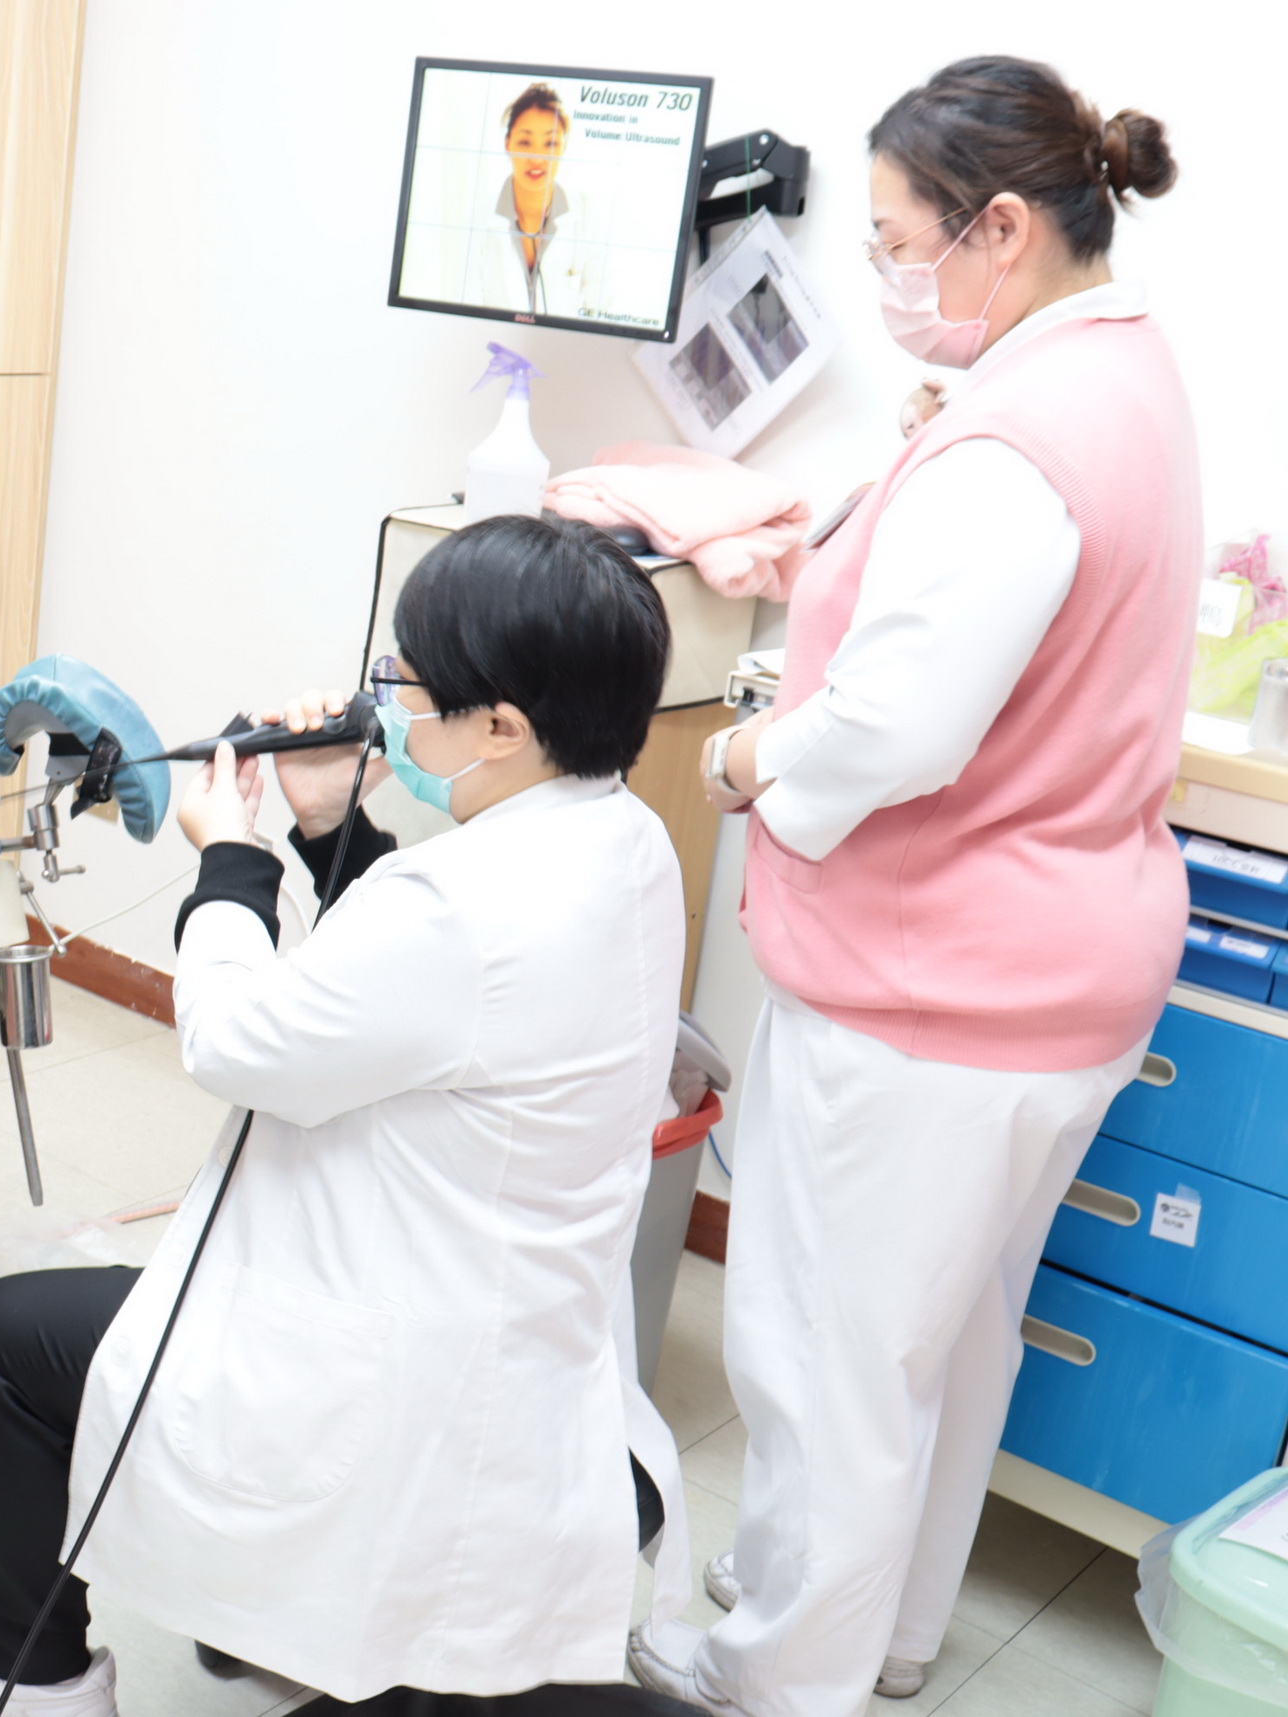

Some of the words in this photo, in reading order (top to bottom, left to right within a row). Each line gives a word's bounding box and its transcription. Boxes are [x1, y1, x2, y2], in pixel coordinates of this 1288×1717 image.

[580, 85, 649, 108] Voluson
[656, 91, 693, 111] 730
[573, 110, 626, 123] Innovation
[629, 115, 638, 124] in
[585, 128, 621, 141] Volume
[625, 131, 680, 146] Ultrasound
[578, 306, 595, 317] GE
[597, 309, 660, 327] Healthcare
